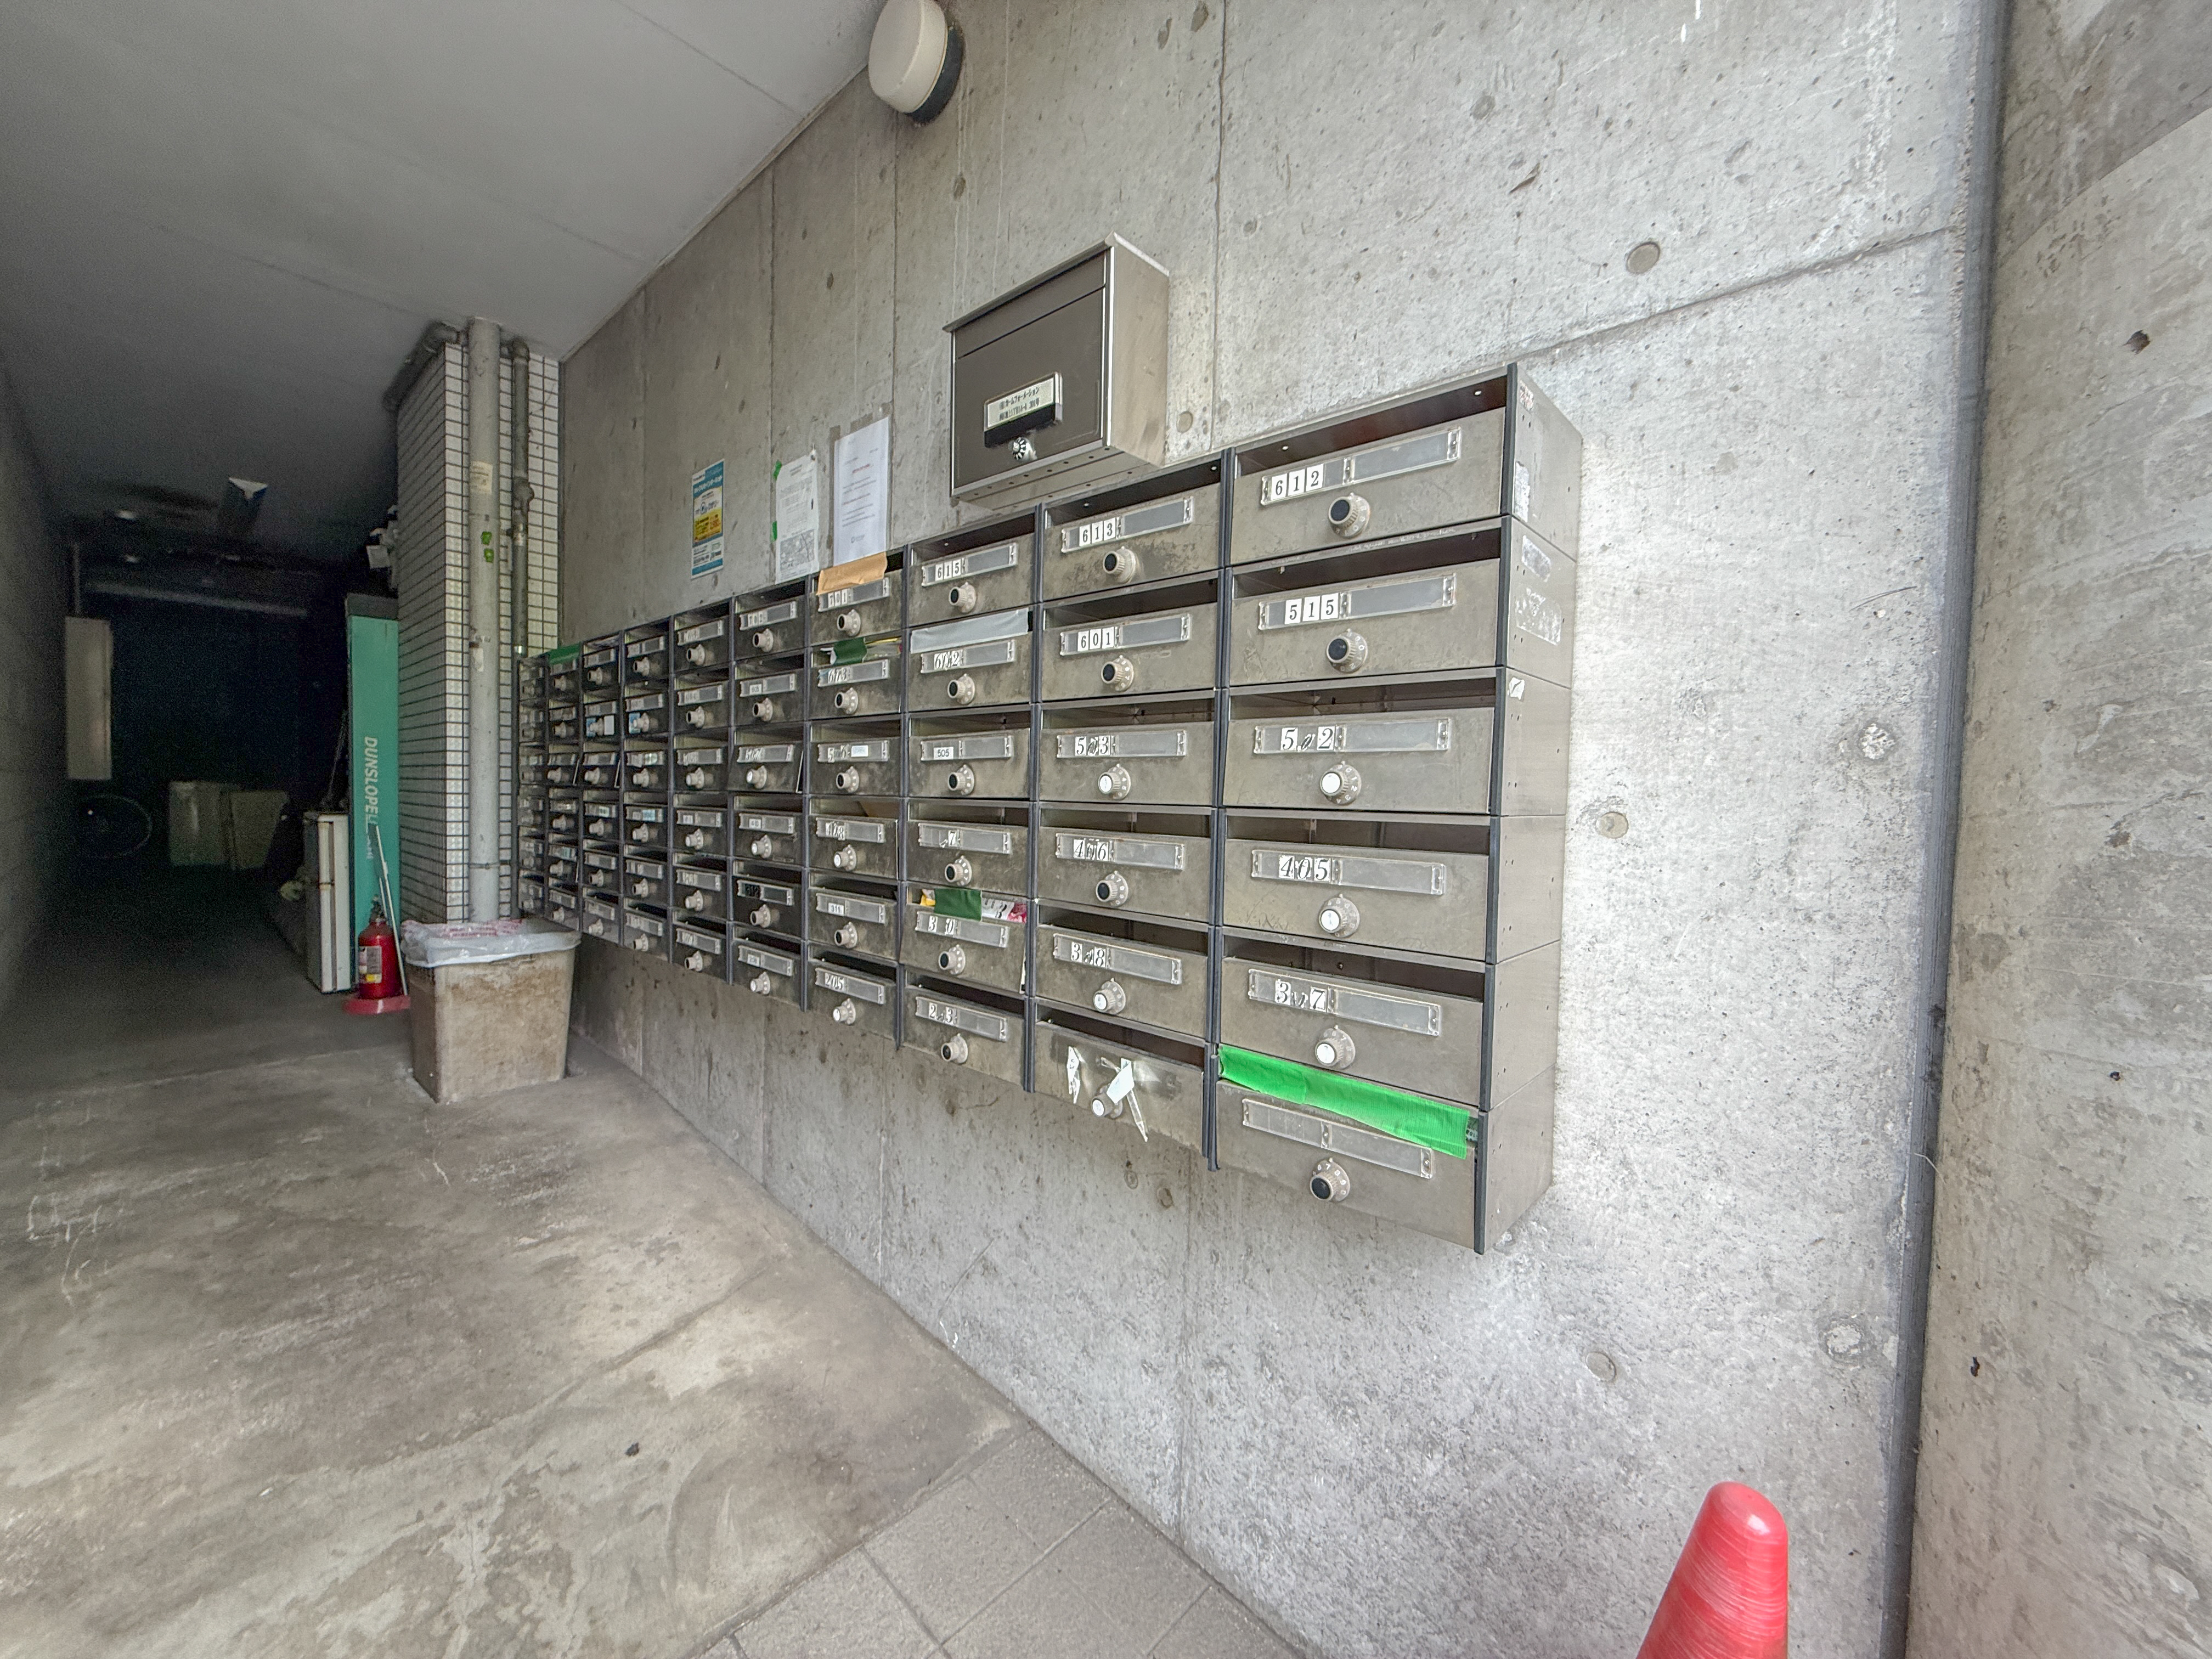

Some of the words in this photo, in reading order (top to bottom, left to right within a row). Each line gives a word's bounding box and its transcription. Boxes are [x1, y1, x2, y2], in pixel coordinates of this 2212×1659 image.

[1276, 470, 1319, 496] 612
[1082, 523, 1113, 543] 613
[938, 562, 959, 578] 615
[830, 592, 845, 605] 701
[1289, 599, 1334, 621] 515
[1081, 632, 1110, 648] 601
[937, 749, 950, 758] 505
[1076, 736, 1109, 755] 503
[1280, 857, 1328, 880] 405
